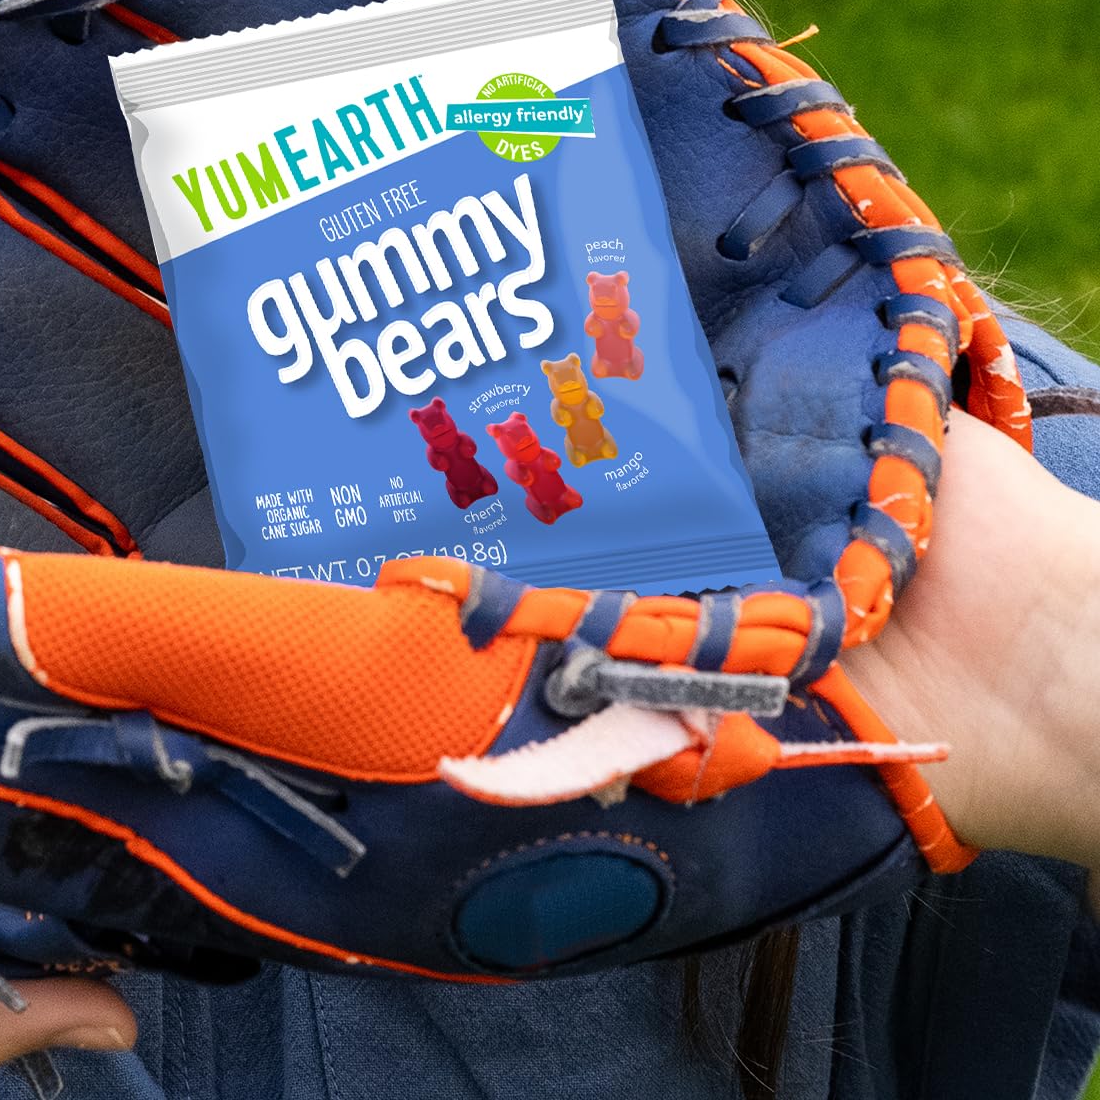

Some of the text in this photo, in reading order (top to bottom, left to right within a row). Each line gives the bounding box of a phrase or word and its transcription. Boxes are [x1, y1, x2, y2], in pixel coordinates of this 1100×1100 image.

[482, 74, 548, 98] NO ARTIFICIAL
[454, 109, 511, 127] allergy
[172, 75, 443, 233] YUMEARTH
[495, 139, 544, 161] DYES
[319, 180, 427, 243] GLUTEN FREE
[585, 238, 623, 254] peach
[587, 255, 625, 264] flavored
[247, 173, 546, 384] gummy
[306, 268, 555, 418] bears
[468, 383, 531, 414] strawberry
[485, 397, 520, 415] flavored
[604, 452, 643, 482] mango
[389, 476, 404, 489] NO
[615, 467, 649, 492] flavored
[256, 488, 314, 509] MADE WITH
[330, 484, 362, 506] NON
[379, 490, 424, 508] ARTIFICIAL
[266, 505, 310, 523] ORGANIC
[335, 506, 367, 528] GMO
[393, 508, 416, 523] DYES
[464, 499, 504, 525] cherry
[261, 520, 322, 540] CANE SUGAR
[473, 515, 507, 535] flavored
[308, 560, 352, 582] WT.
